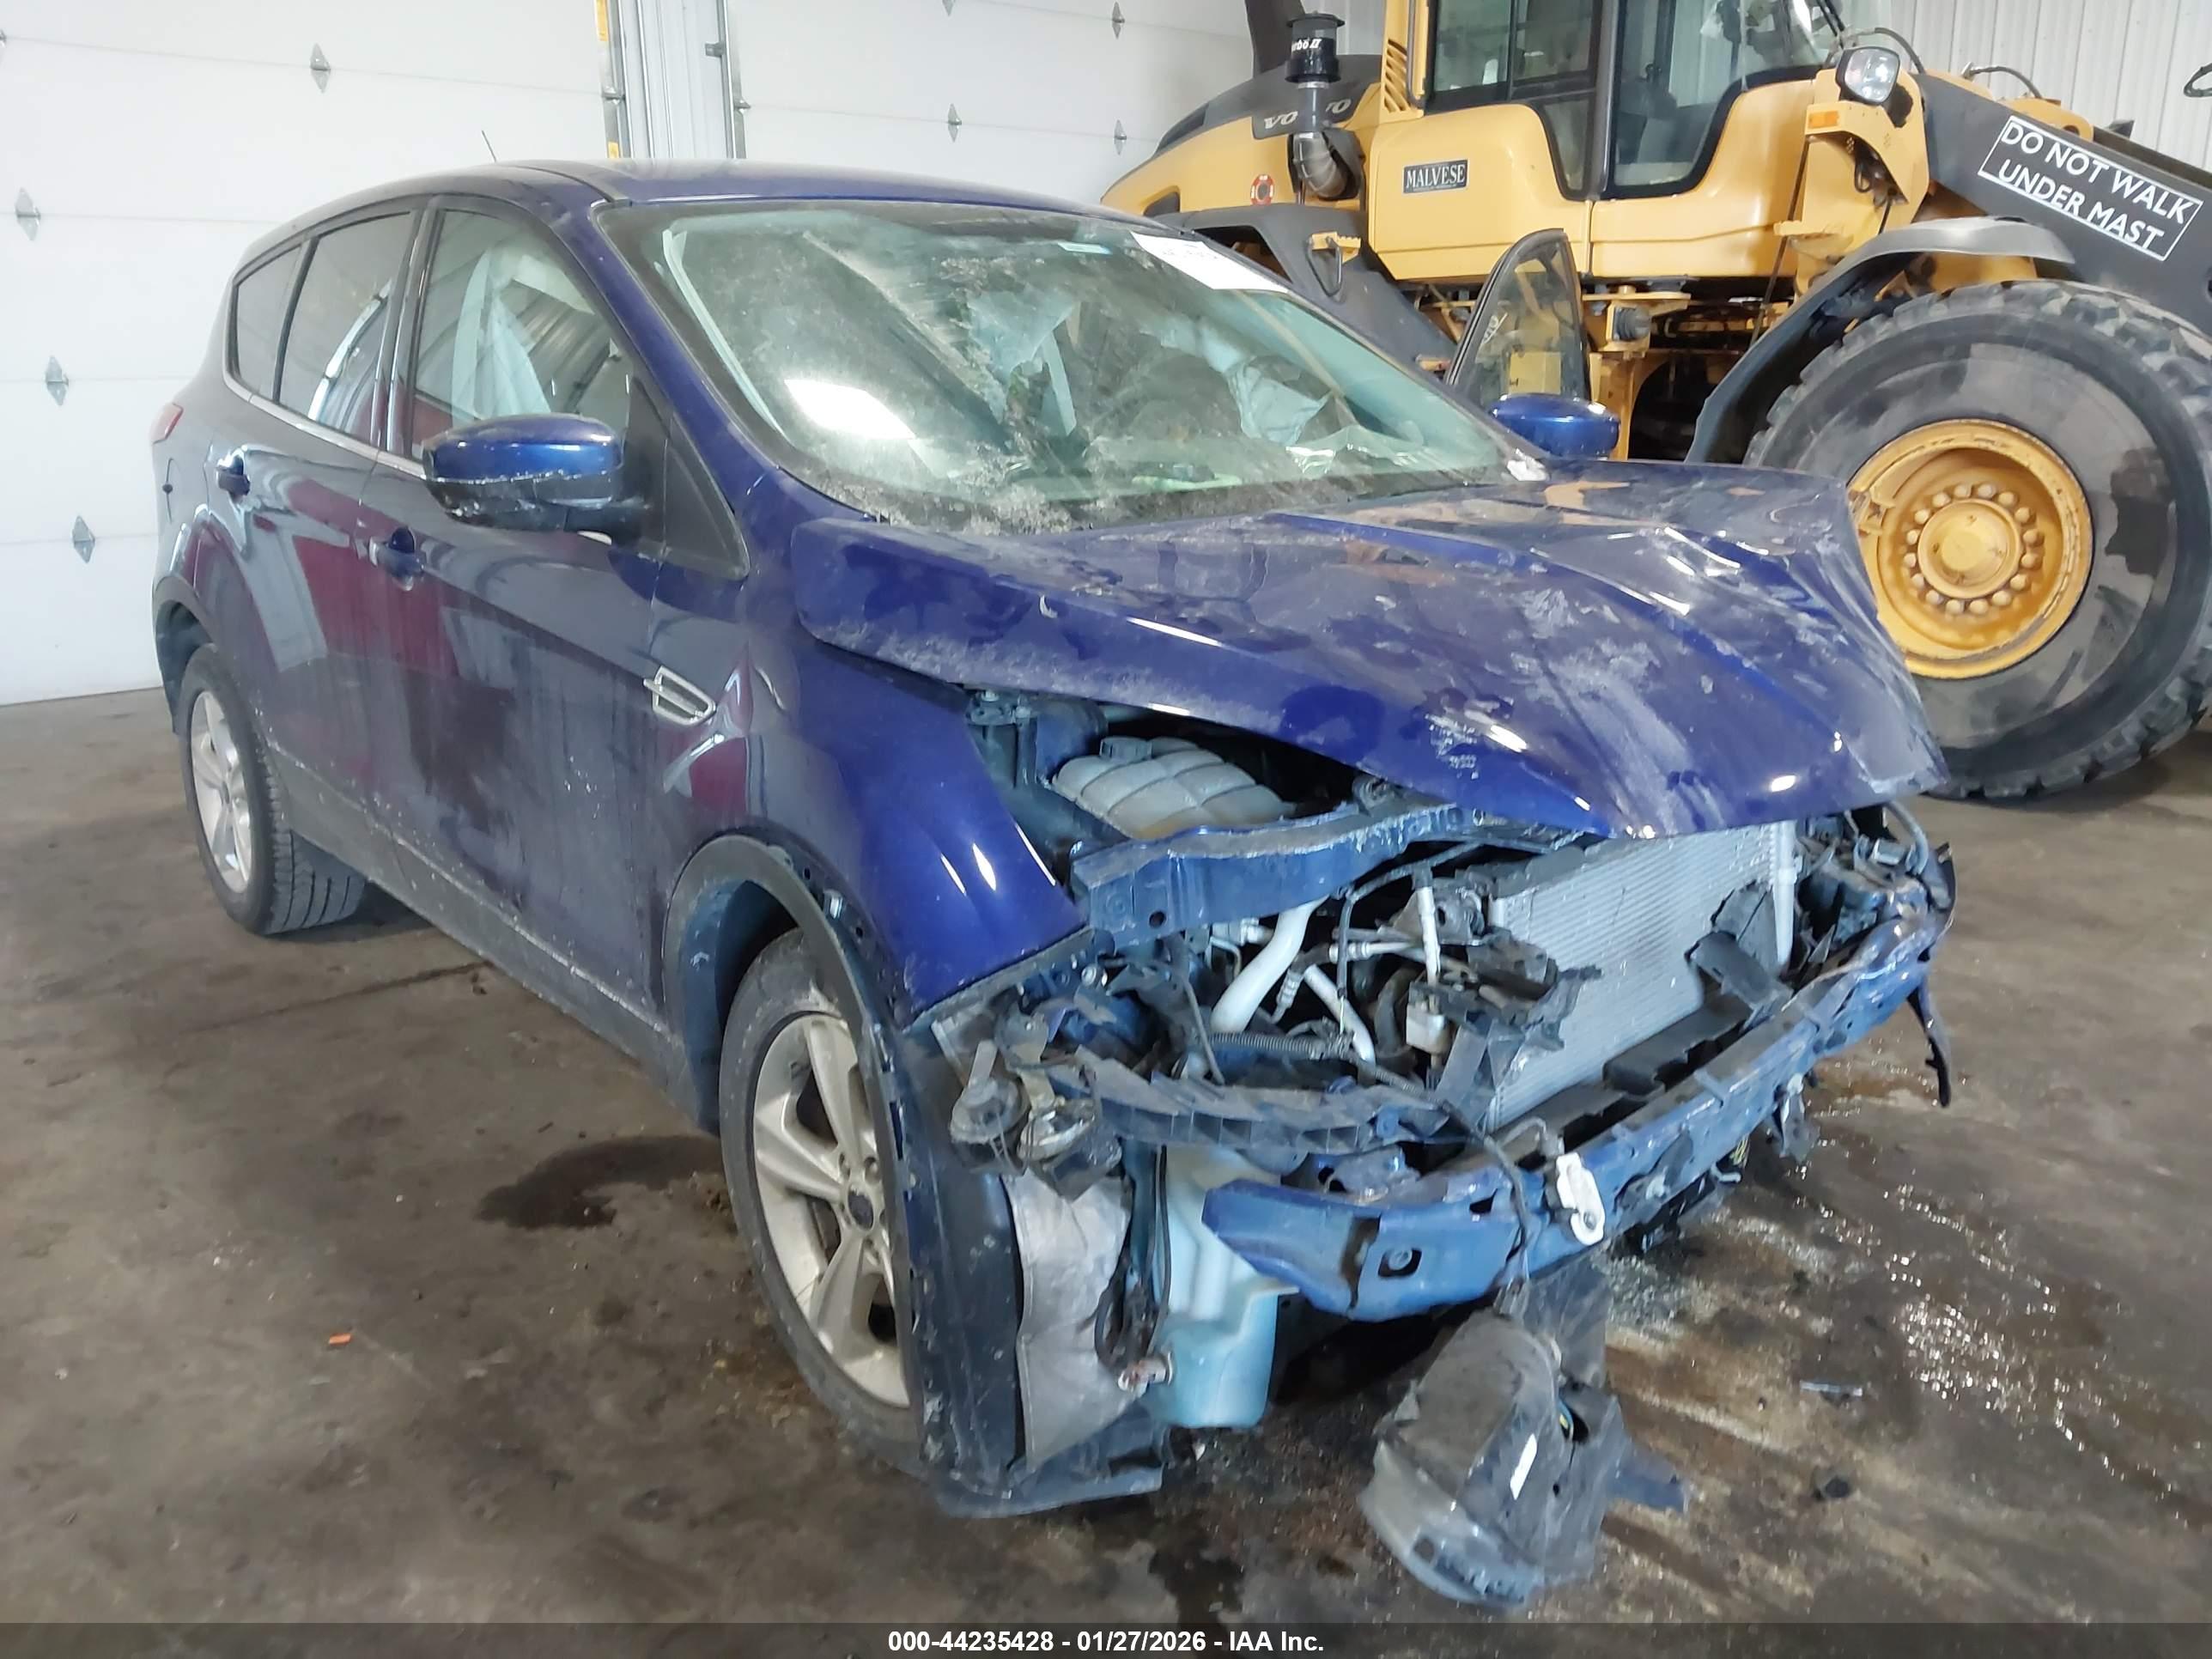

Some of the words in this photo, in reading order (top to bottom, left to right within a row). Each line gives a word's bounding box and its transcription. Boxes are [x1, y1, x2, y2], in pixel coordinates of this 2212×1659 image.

[1406, 164, 1466, 188] MALVESE
[1998, 159, 2085, 217] UNDER
[2087, 202, 2165, 250] MAST
[2001, 122, 2044, 154] DO
[2045, 142, 2109, 184] NOT
[2111, 170, 2194, 224] WALK
